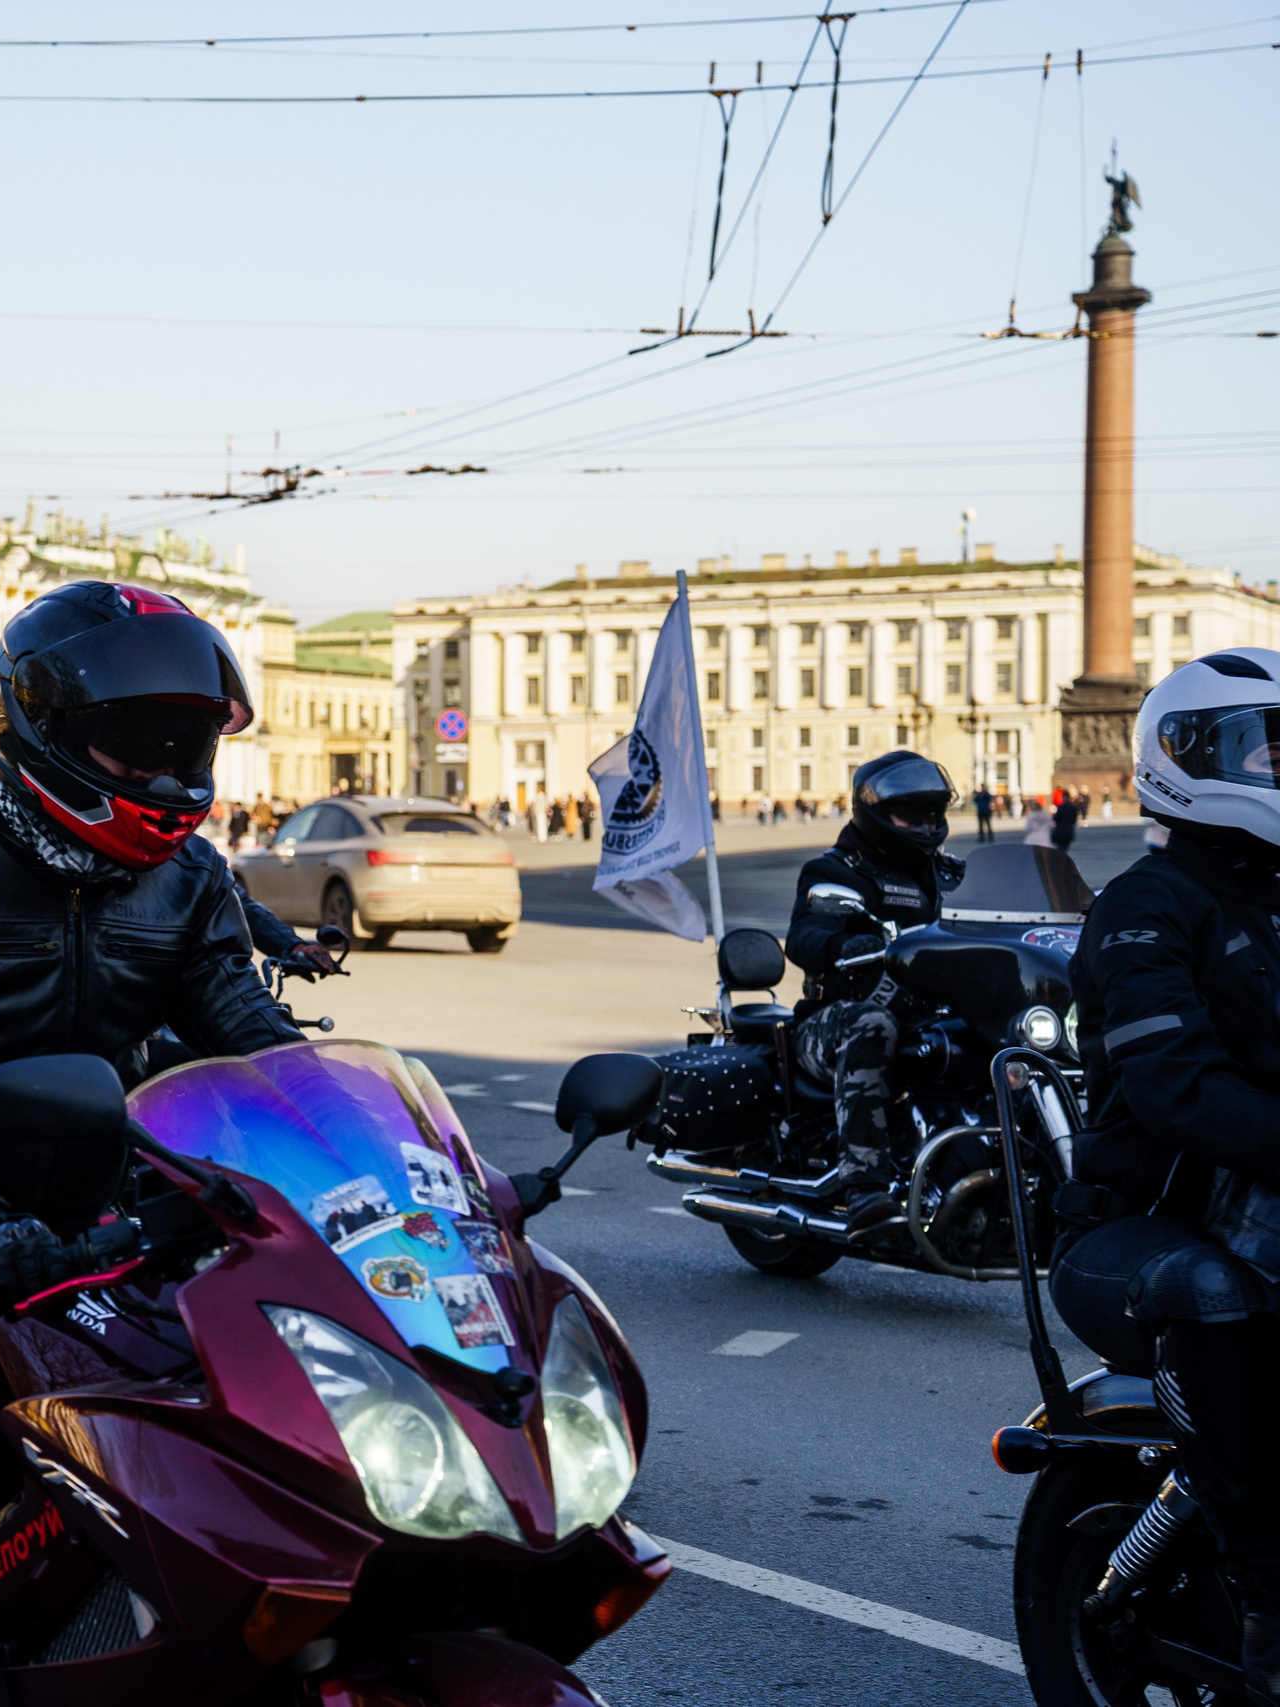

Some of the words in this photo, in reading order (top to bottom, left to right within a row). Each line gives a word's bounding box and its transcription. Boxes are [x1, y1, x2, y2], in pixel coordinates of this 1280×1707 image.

[1144, 771, 1193, 808] LS2
[1100, 929, 1160, 951] LS2
[66, 1308, 107, 1336] NDA
